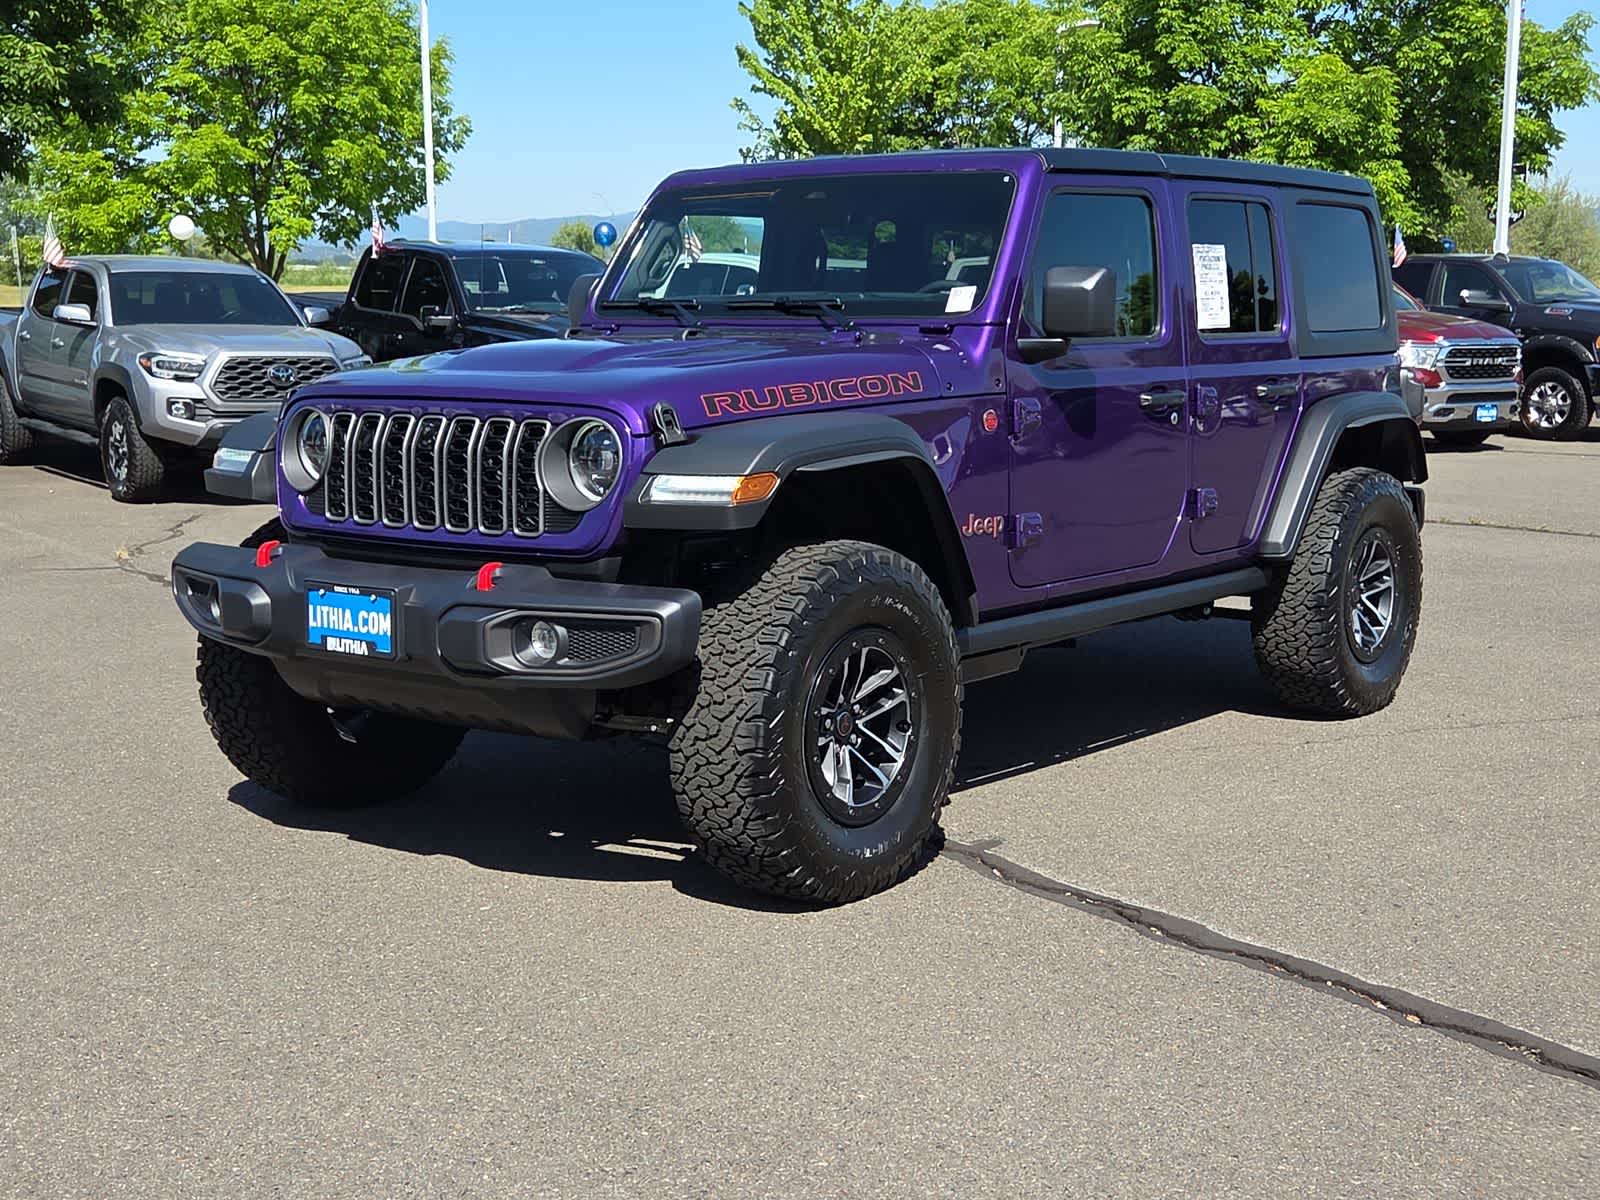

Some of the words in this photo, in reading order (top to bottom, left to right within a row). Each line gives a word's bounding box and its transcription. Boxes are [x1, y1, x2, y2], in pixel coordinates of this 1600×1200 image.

[1473, 357, 1503, 366] RAM
[701, 371, 923, 417] RUBICON
[962, 513, 1004, 538] Jeep
[308, 604, 391, 636] LITHIA.COM
[336, 638, 369, 656] LITHIA
